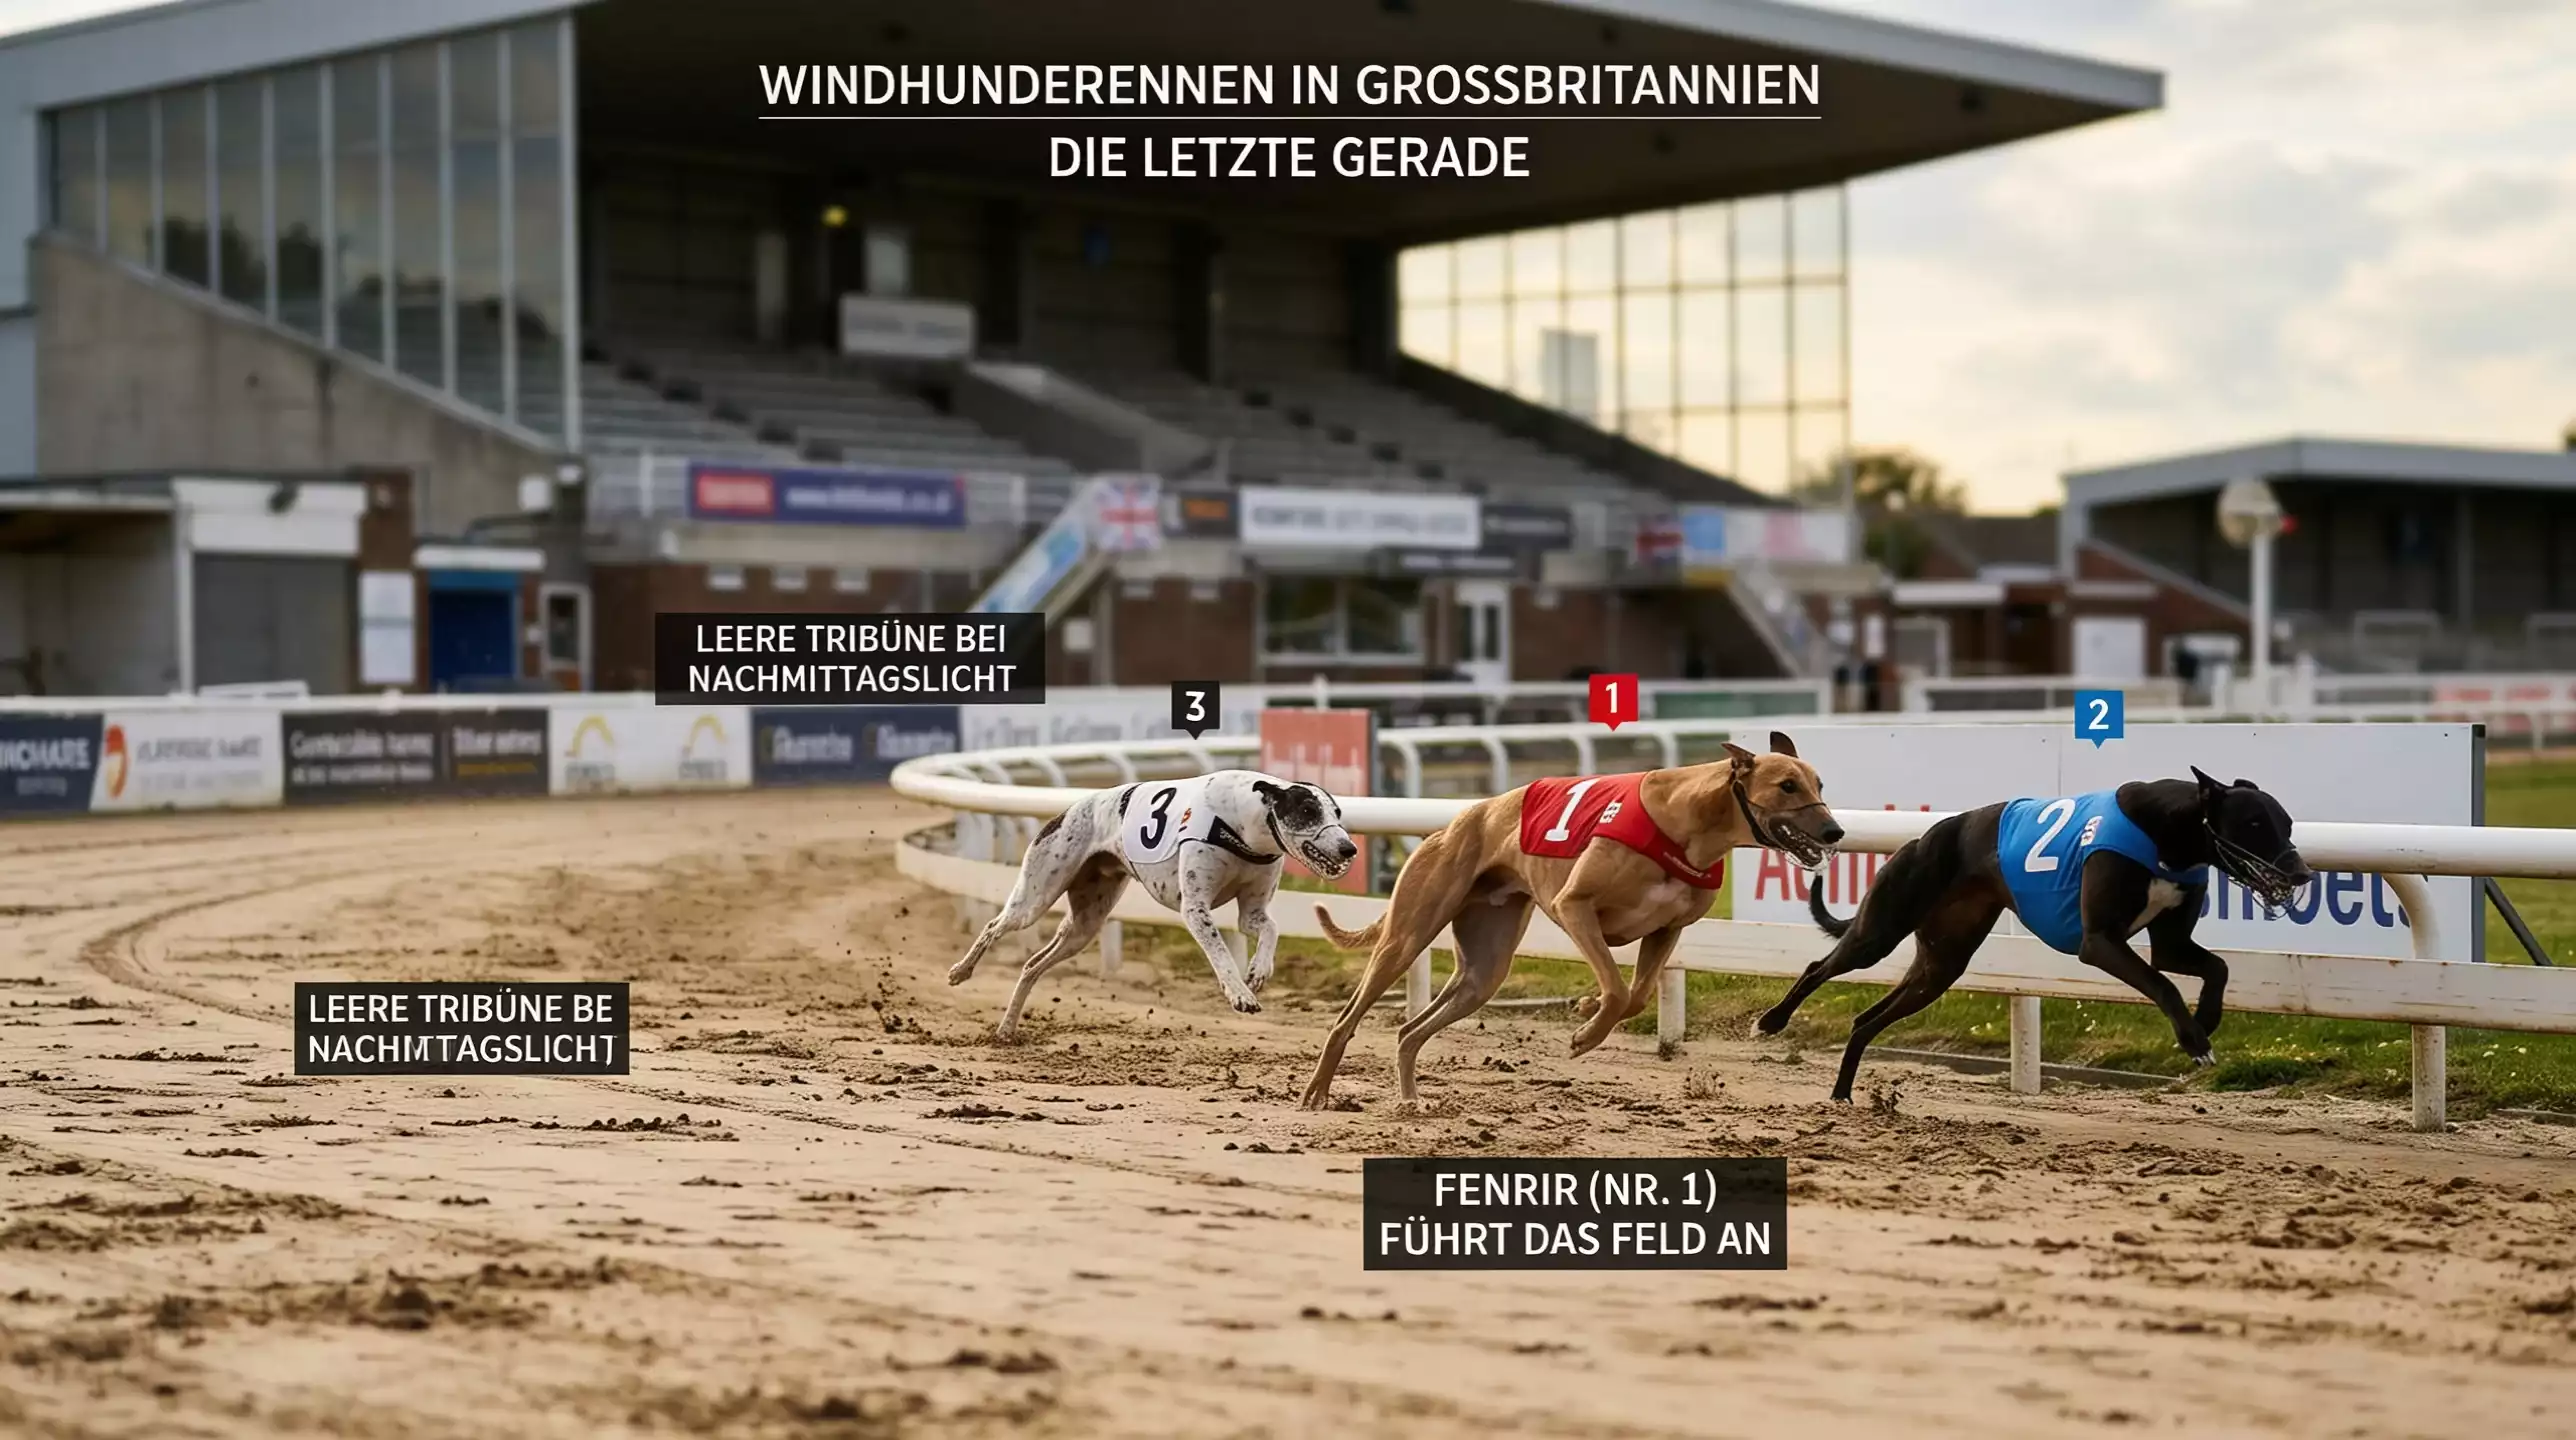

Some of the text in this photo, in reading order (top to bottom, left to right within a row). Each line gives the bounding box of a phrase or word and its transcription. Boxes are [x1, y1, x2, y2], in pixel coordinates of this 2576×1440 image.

[1140, 787, 1178, 850] 3
[1544, 778, 1602, 842] 1
[2023, 799, 2077, 873] 2
